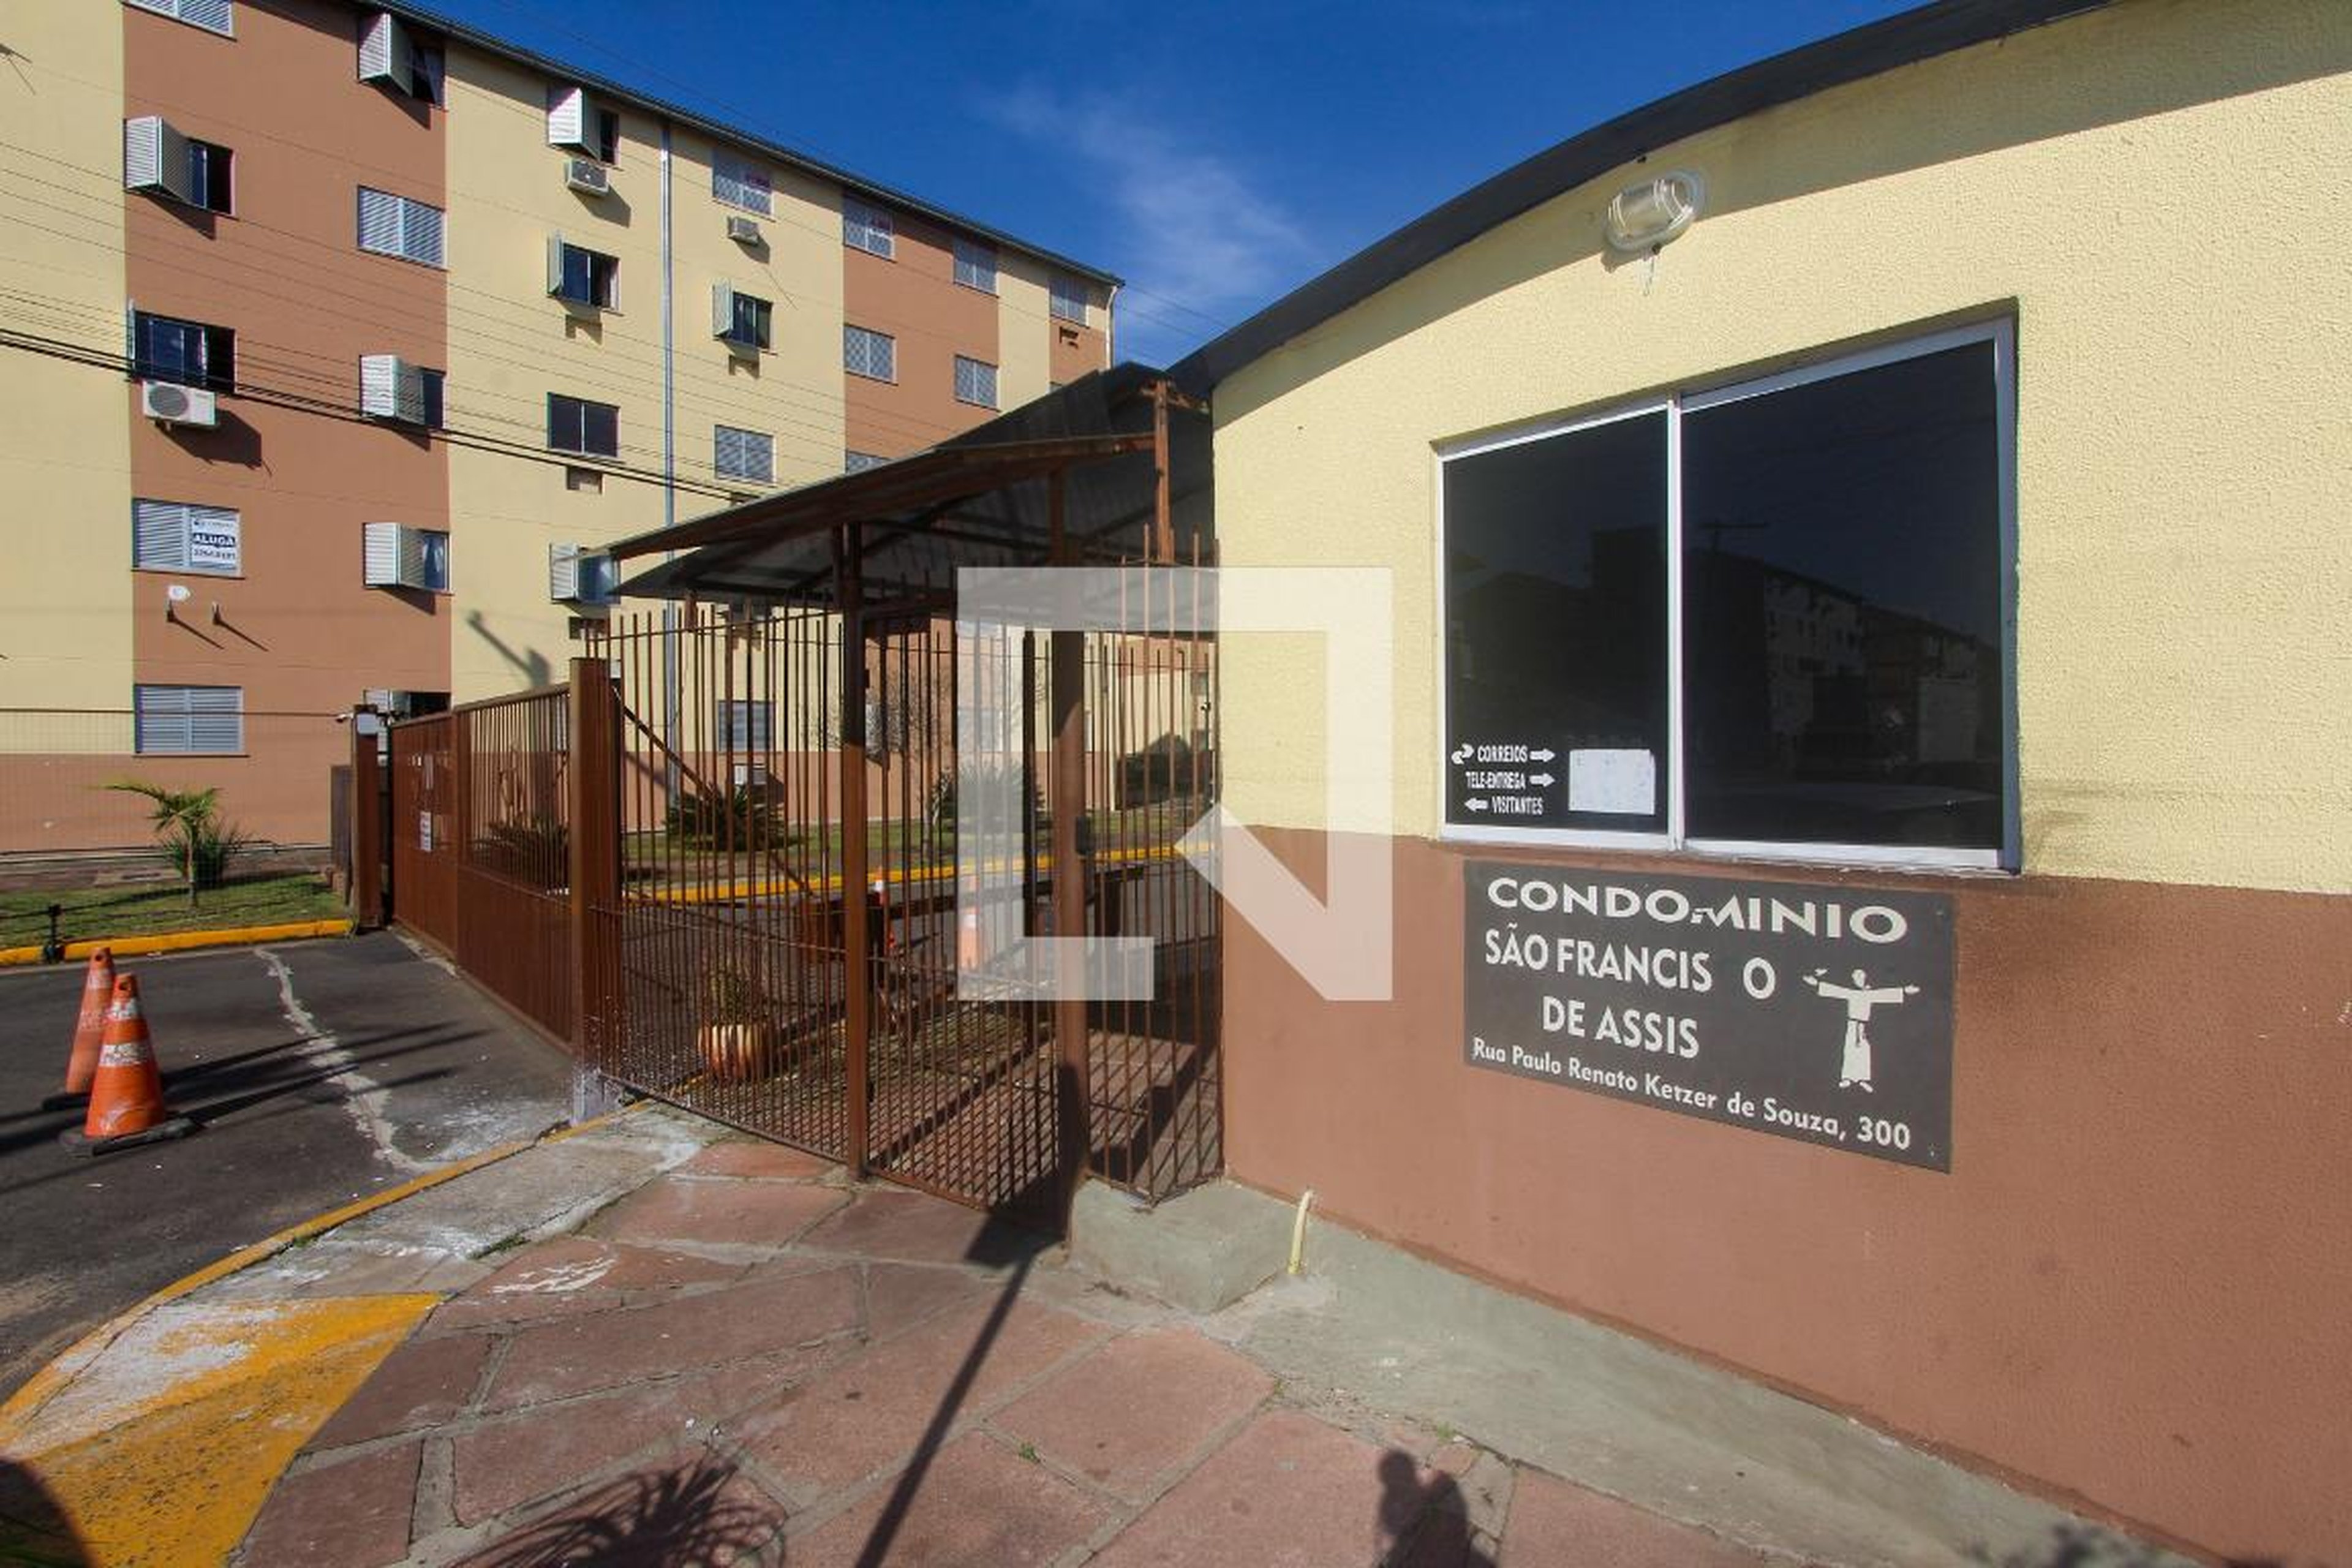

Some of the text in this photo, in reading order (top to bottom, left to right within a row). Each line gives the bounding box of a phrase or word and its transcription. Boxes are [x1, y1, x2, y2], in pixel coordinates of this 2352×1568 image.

[193, 534, 234, 546] ALUGA
[1477, 744, 1528, 763] CORREIOS
[1465, 771, 1526, 790] TELE-ENTREGA
[1492, 796, 1544, 815] VISITANTES
[1488, 877, 1907, 943] CONDOMINIO
[1485, 922, 1549, 970] SÃO
[1543, 996, 1699, 1058] DE ASSIS
[1473, 1037, 1506, 1063] Rua
[1512, 1045, 1561, 1075] Paulo
[1568, 1057, 1638, 1091] Renato
[1727, 1091, 1755, 1117] de
[1763, 1098, 1846, 1141] Souza,
[1857, 1116, 1910, 1150] 300
